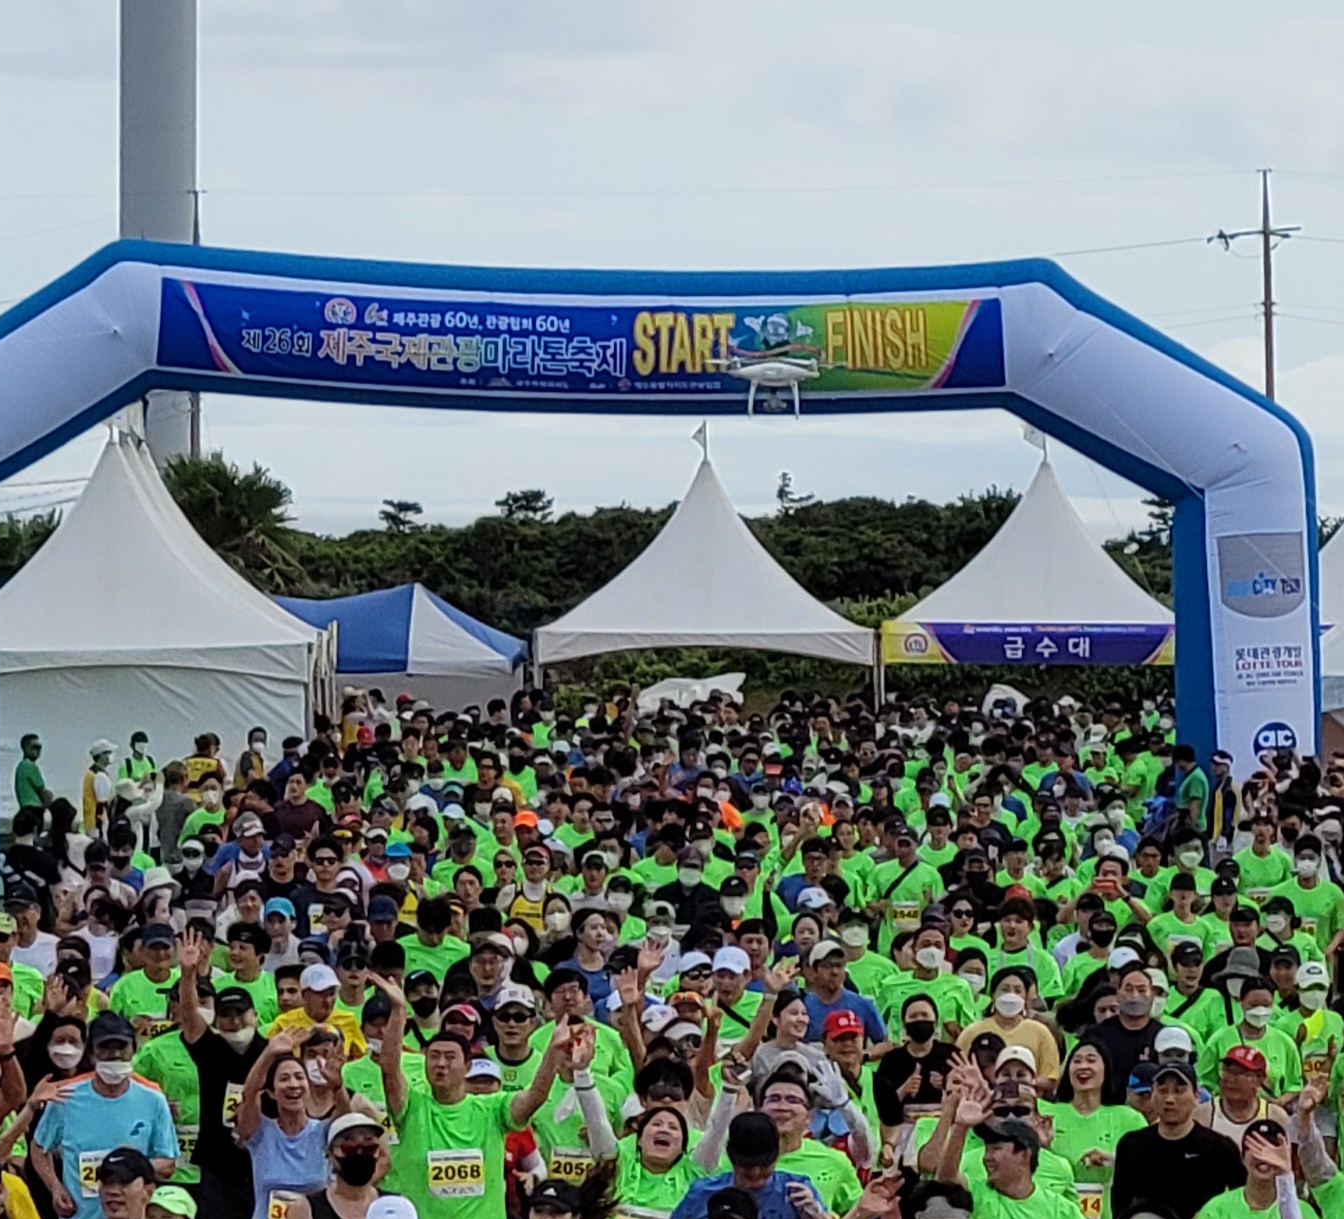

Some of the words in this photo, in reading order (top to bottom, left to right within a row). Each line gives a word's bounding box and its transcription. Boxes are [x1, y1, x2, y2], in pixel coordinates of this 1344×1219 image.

[318, 327, 628, 378] 제주국제관광마라톤축제
[632, 311, 735, 377] START
[824, 308, 927, 370] FINISH
[1003, 636, 1091, 658] 급수대
[431, 1164, 481, 1181] 2068
